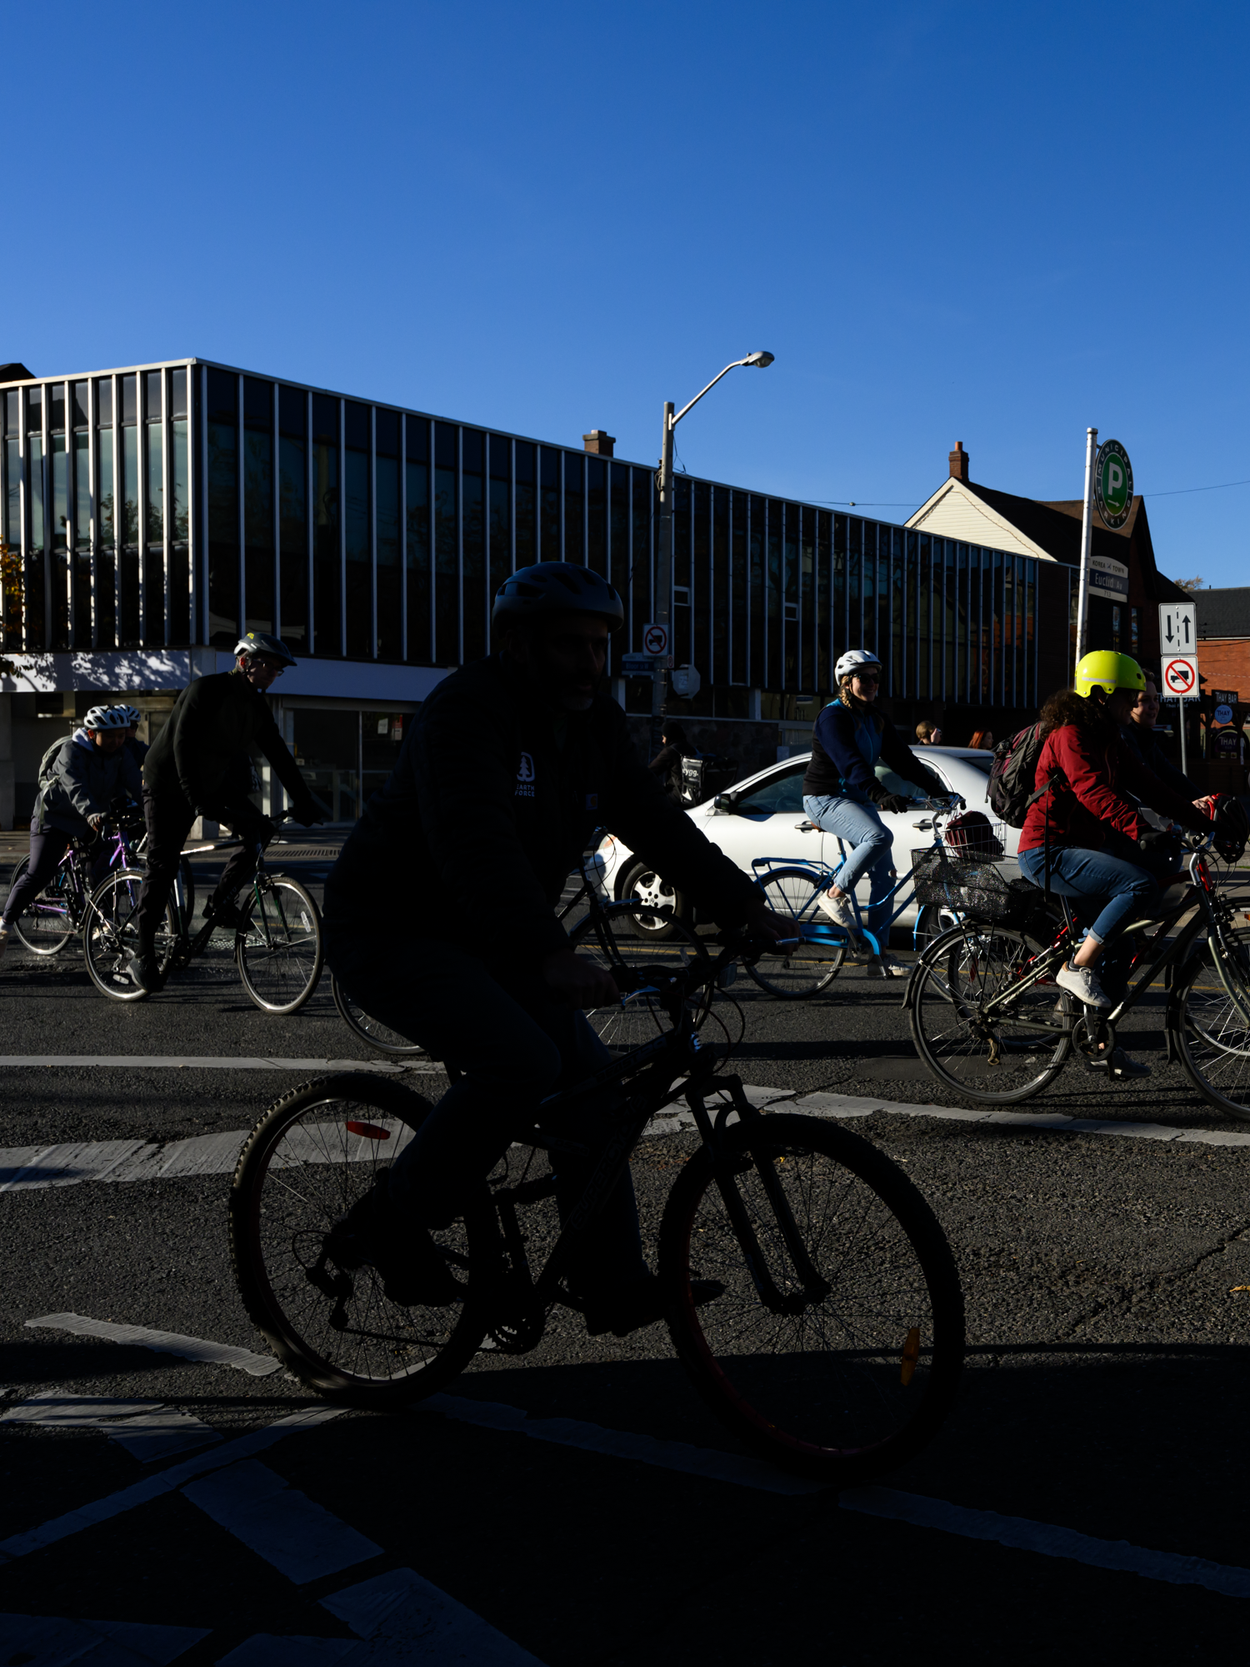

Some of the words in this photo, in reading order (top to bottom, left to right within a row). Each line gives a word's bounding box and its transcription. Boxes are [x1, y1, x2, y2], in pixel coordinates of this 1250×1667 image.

[1098, 445, 1132, 491] MUNICIPAL
[1108, 461, 1123, 497] P
[1092, 560, 1106, 569] KOREA
[1112, 565, 1125, 574] TOWN
[1095, 572, 1114, 588] Euclid
[626, 662, 639, 670] Bloor
[1215, 691, 1227, 704] THAY
[1228, 694, 1238, 705] BAR
[1219, 737, 1237, 746] THAY
[514, 789, 535, 797] FORCE
[516, 783, 535, 791] EARTH
[595, 1052, 640, 1083] BEAST
